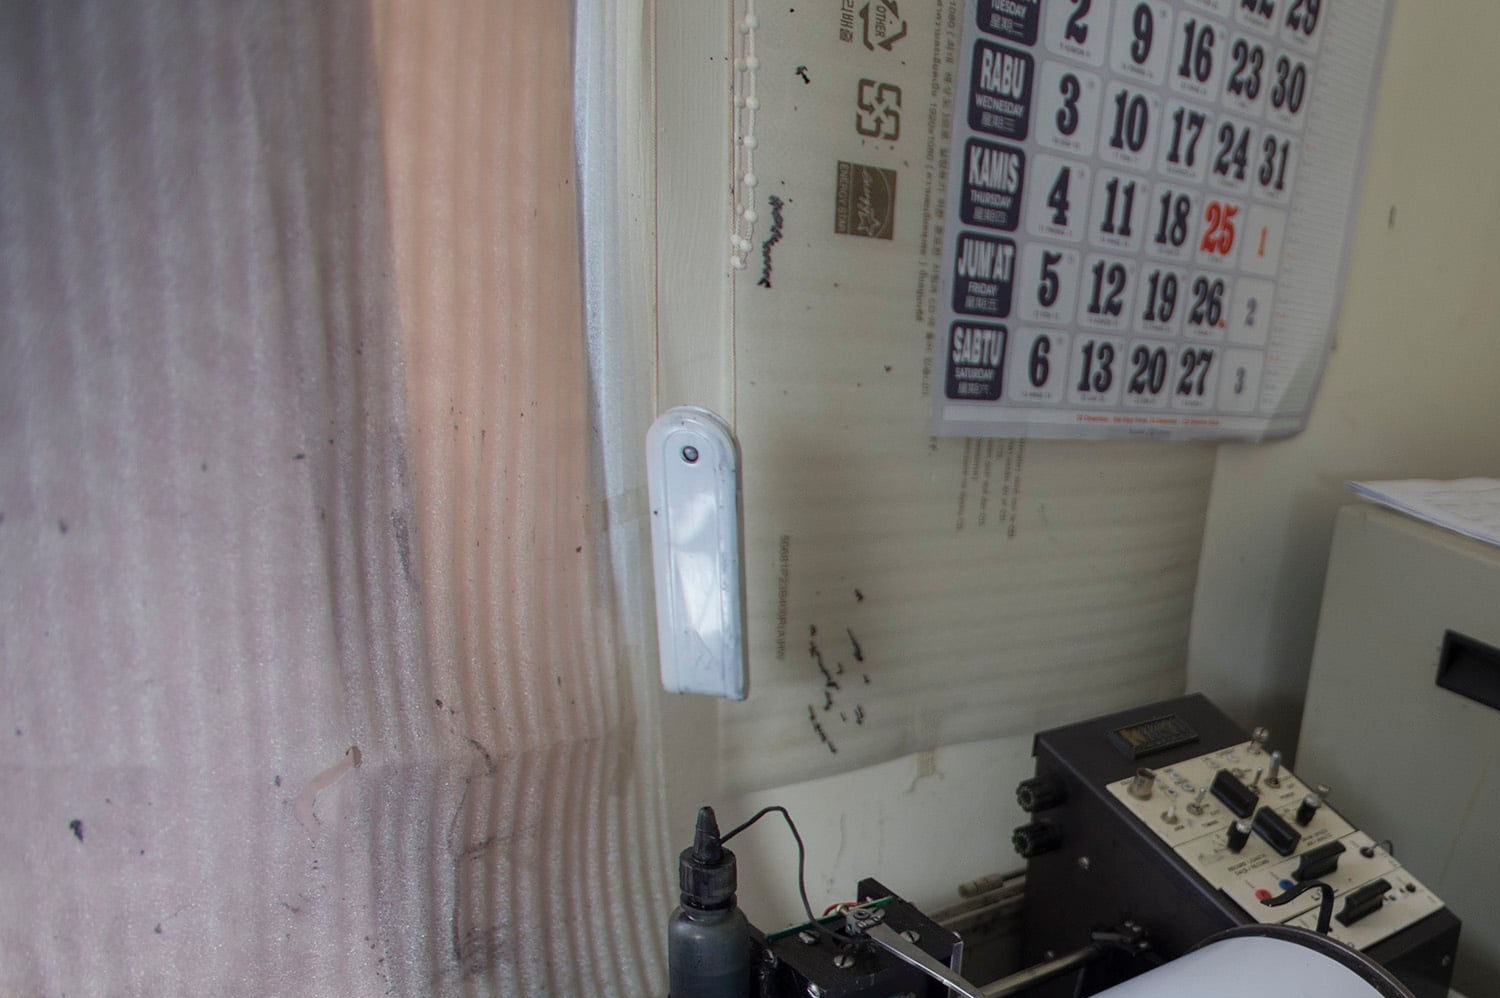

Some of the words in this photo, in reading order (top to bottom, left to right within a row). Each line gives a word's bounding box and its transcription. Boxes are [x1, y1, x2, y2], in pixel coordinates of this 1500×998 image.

[874, 6, 887, 38] OTHER
[980, 48, 1026, 99] RABU
[1065, 0, 1091, 45] 2
[1131, 3, 1154, 64] 9
[1179, 18, 1215, 82] 16
[1227, 38, 1264, 100] 23
[1272, 54, 1306, 114] 30
[975, 93, 1025, 117] WEDNESDAY
[1056, 73, 1080, 135] 3
[1110, 88, 1149, 153] 10
[1167, 106, 1206, 167] 17
[1213, 120, 1251, 181] 24
[1258, 134, 1290, 191] 31
[838, 163, 849, 205] ENERGY
[969, 145, 1019, 194] KAMIS
[836, 206, 847, 233] STAR
[970, 189, 1011, 209] THURSDAY
[1046, 166, 1071, 226] 4
[1101, 176, 1136, 237] 11
[1154, 189, 1191, 247] 18
[1201, 200, 1239, 257] 25
[1257, 226, 1269, 257] 1
[968, 281, 999, 297] FRIDAY
[1037, 250, 1062, 308] 5
[1087, 259, 1126, 317] 12
[1143, 269, 1177, 323] 19
[1187, 277, 1225, 328] 26
[1243, 296, 1258, 327] 2
[952, 327, 1003, 367] SABTU
[1028, 334, 1051, 388] 6
[1077, 340, 1115, 394] 13
[1127, 343, 1167, 395] 20
[1176, 347, 1213, 397] 27
[1233, 368, 1246, 395] 3
[955, 366, 995, 381] SATURDAY
